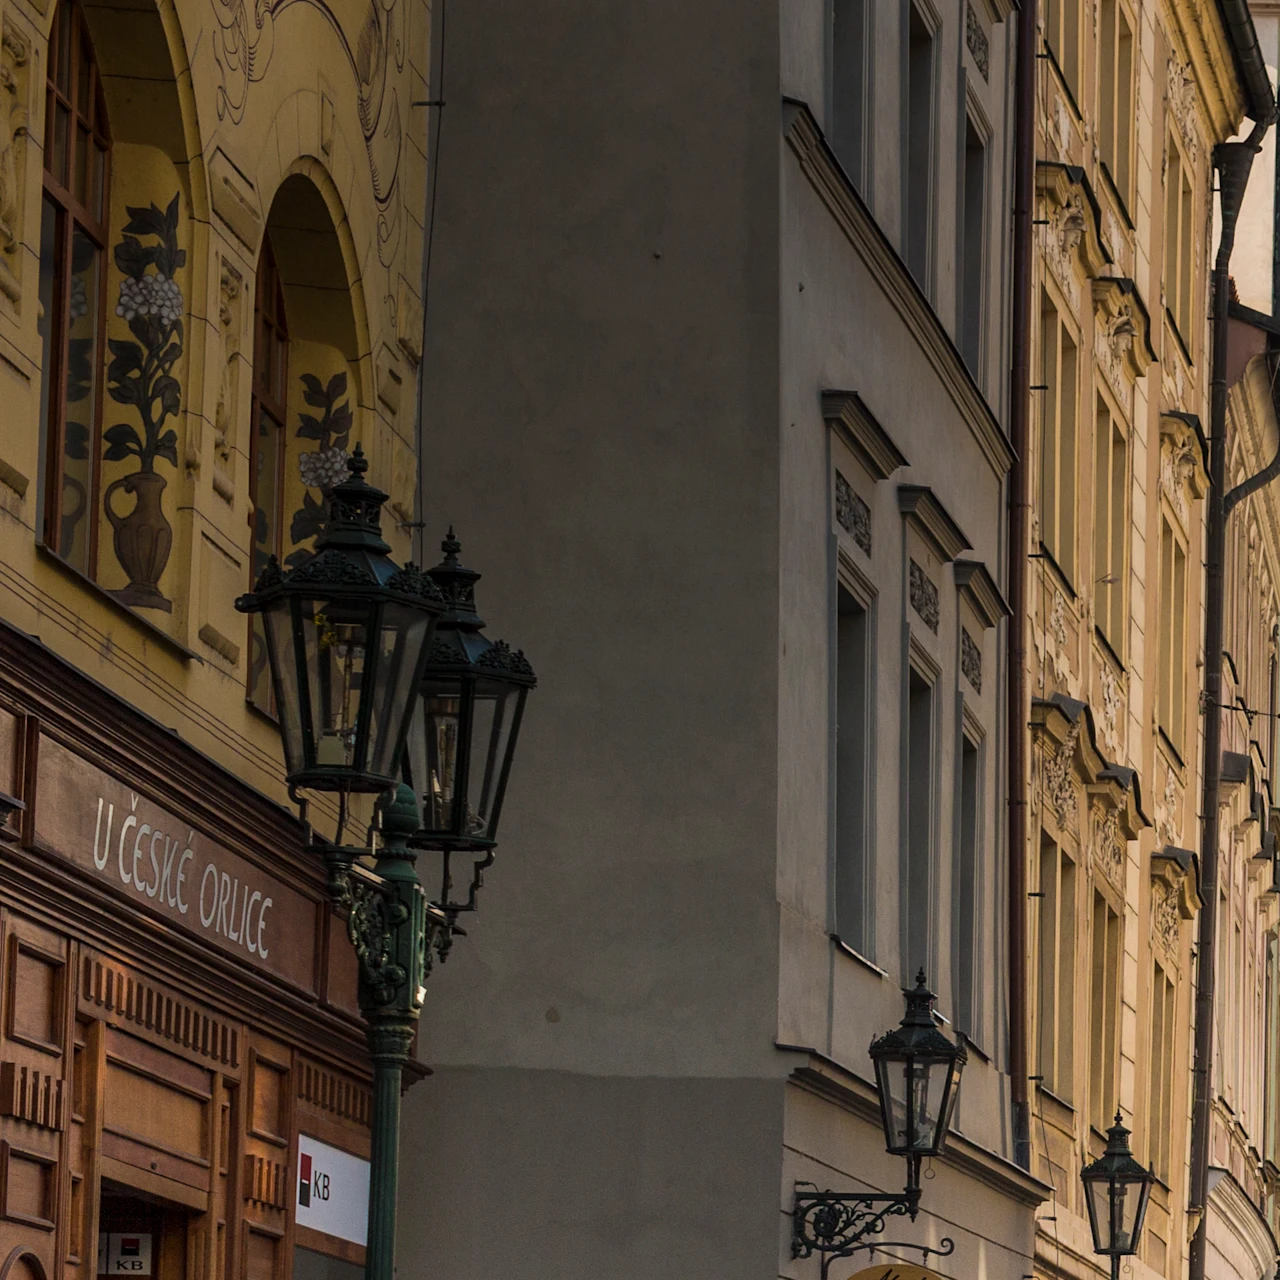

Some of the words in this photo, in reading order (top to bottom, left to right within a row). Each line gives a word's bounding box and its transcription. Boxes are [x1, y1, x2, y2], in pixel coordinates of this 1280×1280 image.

[94, 797, 114, 871] U
[119, 792, 194, 915] ČESKÉ
[199, 863, 273, 960] ORLICE
[312, 1170, 331, 1202] KB
[116, 1260, 144, 1272] KB
